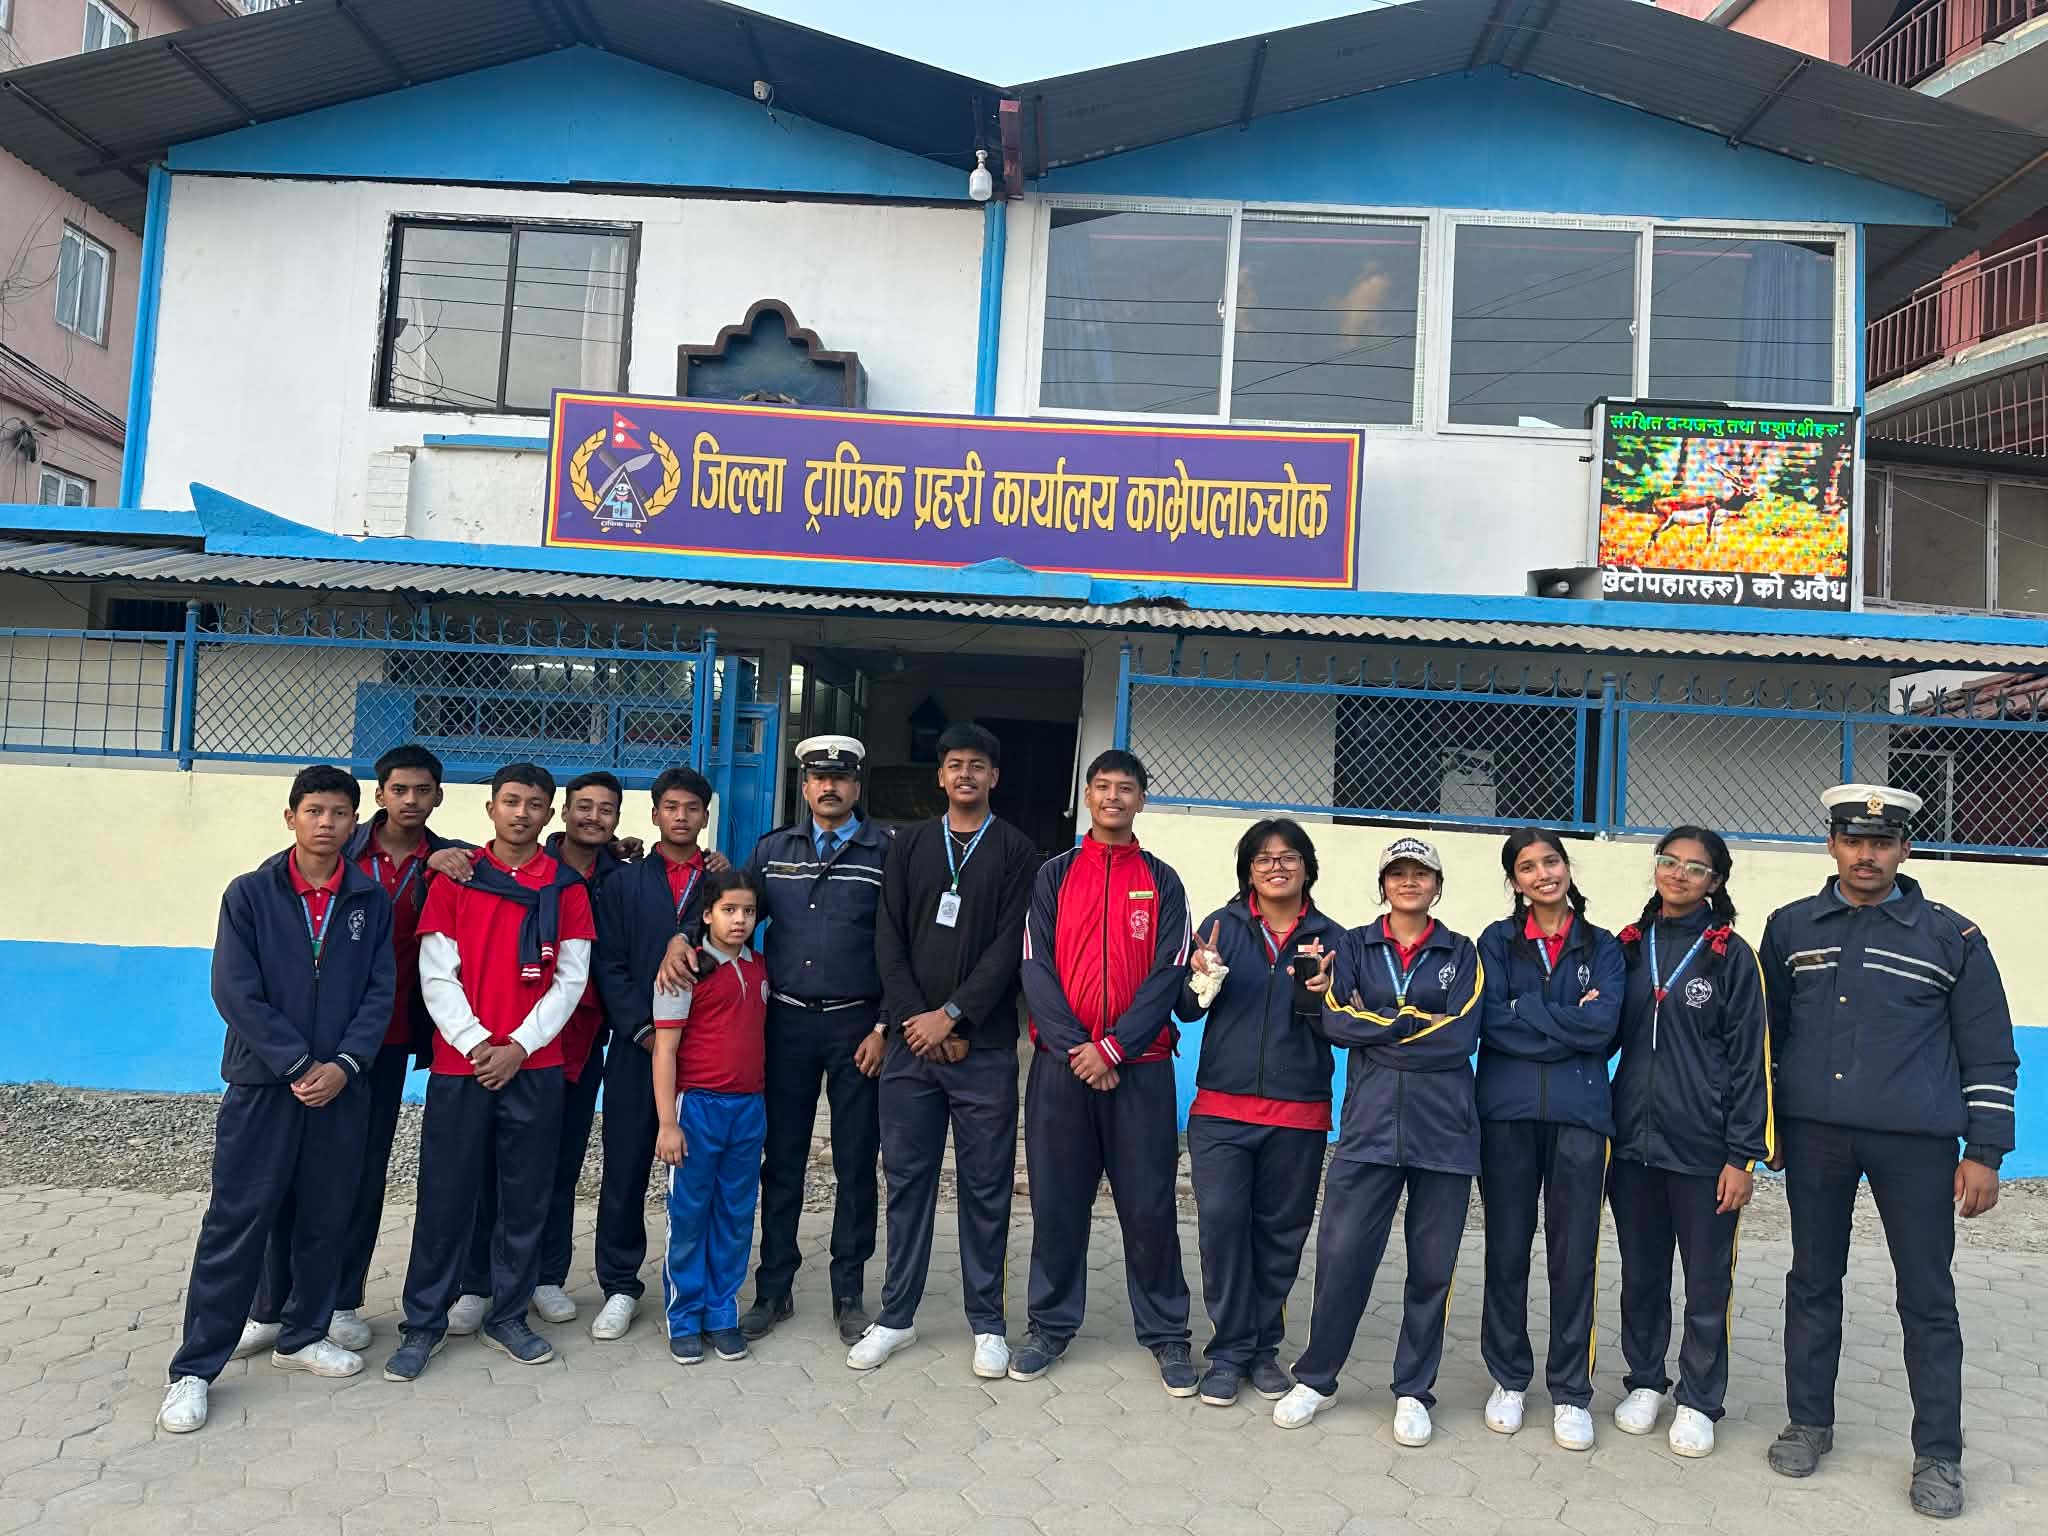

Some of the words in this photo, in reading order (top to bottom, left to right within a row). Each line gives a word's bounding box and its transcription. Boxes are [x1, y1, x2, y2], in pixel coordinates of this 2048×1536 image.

[1609, 411, 1664, 431] संरक्षित
[1726, 419, 1757, 435] तथा
[691, 432, 787, 515] जिल्ला
[804, 441, 906, 534] ट्राफिक
[914, 451, 985, 530] प्रहरी
[992, 457, 1119, 533] कार्यालय
[1126, 459, 1332, 542] काभ्रेपलाञ्चोक
[1751, 571, 1785, 600] को
[1790, 573, 1847, 602] अवैध
